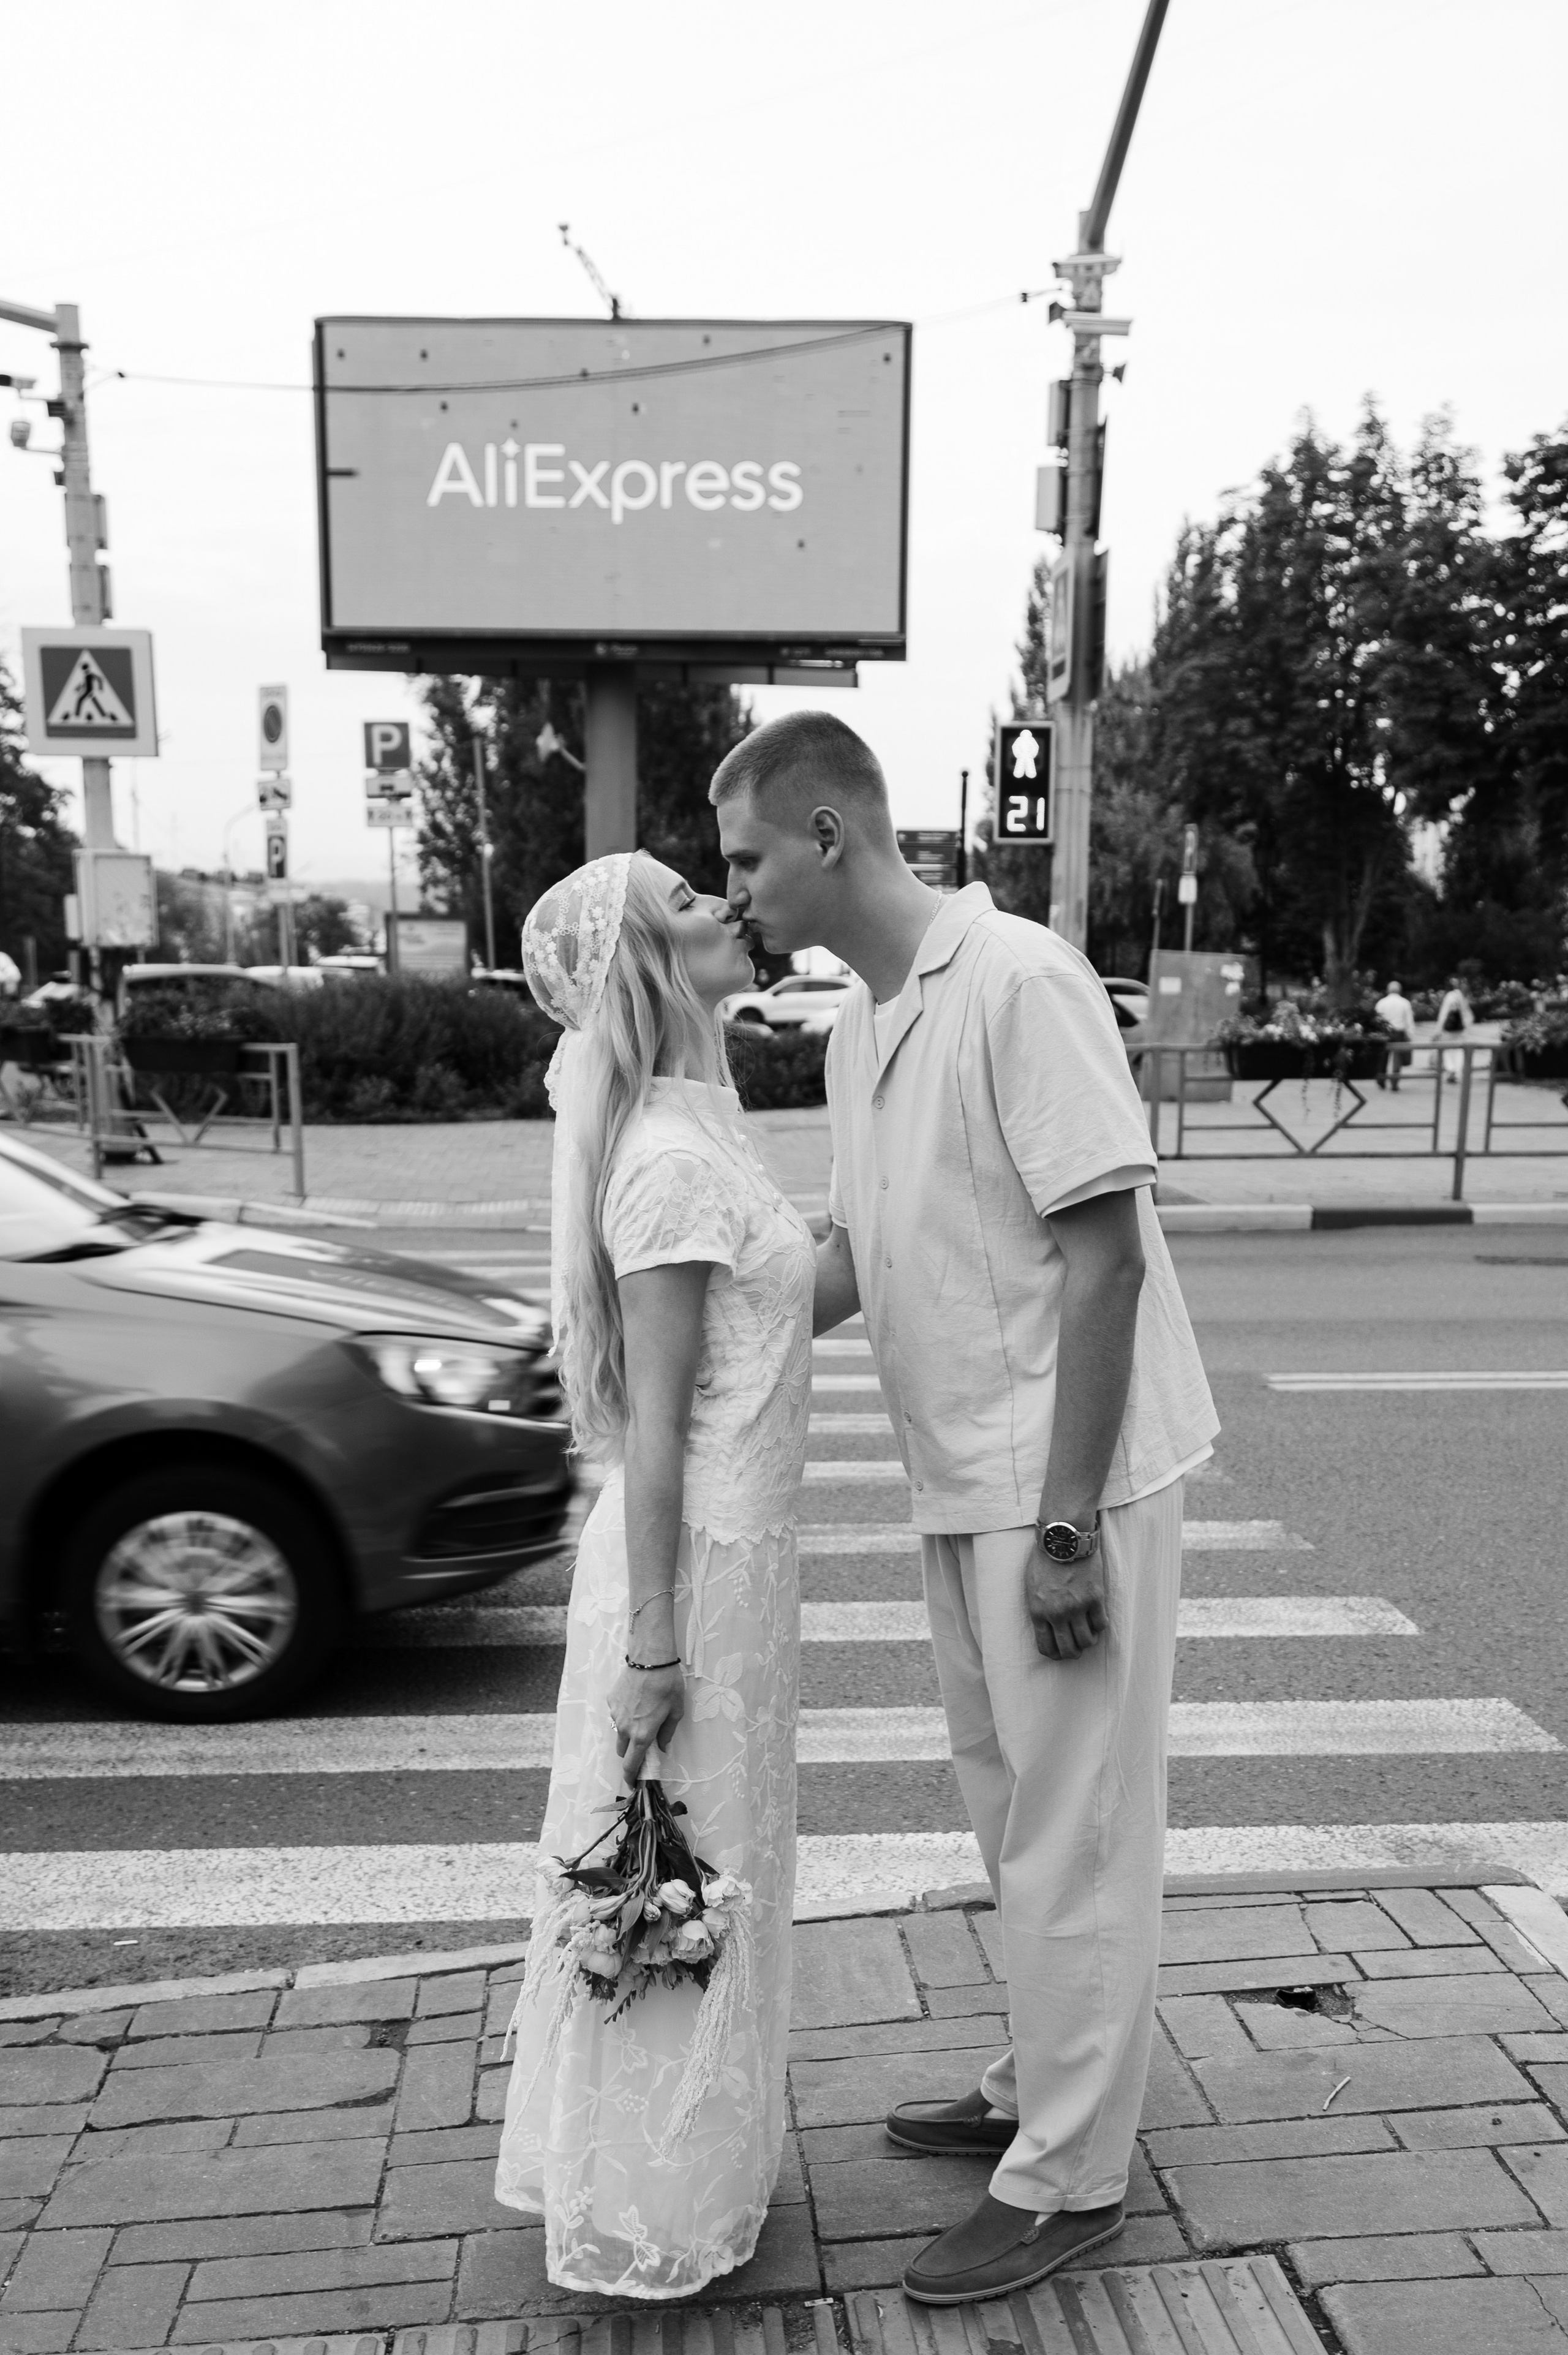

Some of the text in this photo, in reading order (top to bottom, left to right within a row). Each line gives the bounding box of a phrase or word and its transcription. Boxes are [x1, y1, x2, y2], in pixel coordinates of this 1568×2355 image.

[426, 437, 804, 525] AliExpress
[372, 724, 402, 765] P
[1007, 796, 1045, 832] 21
[270, 838, 284, 876] P
